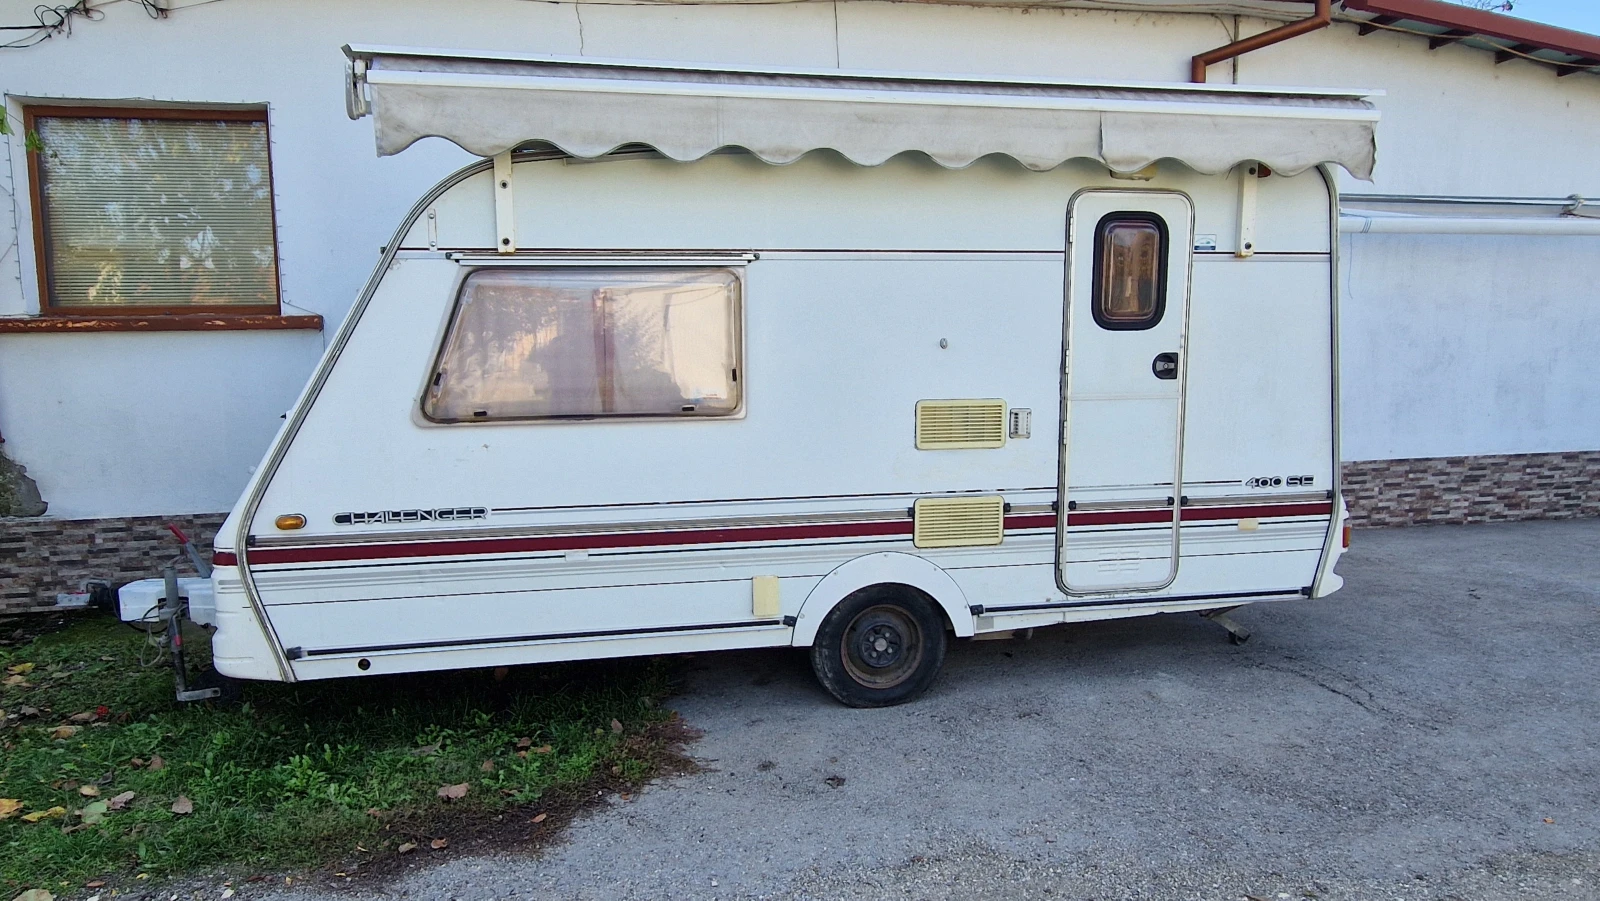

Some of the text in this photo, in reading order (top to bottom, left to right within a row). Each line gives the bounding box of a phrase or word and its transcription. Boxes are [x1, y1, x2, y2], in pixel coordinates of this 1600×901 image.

[1245, 475, 1315, 489] 400 SE
[333, 507, 488, 525] CHALLENGER
